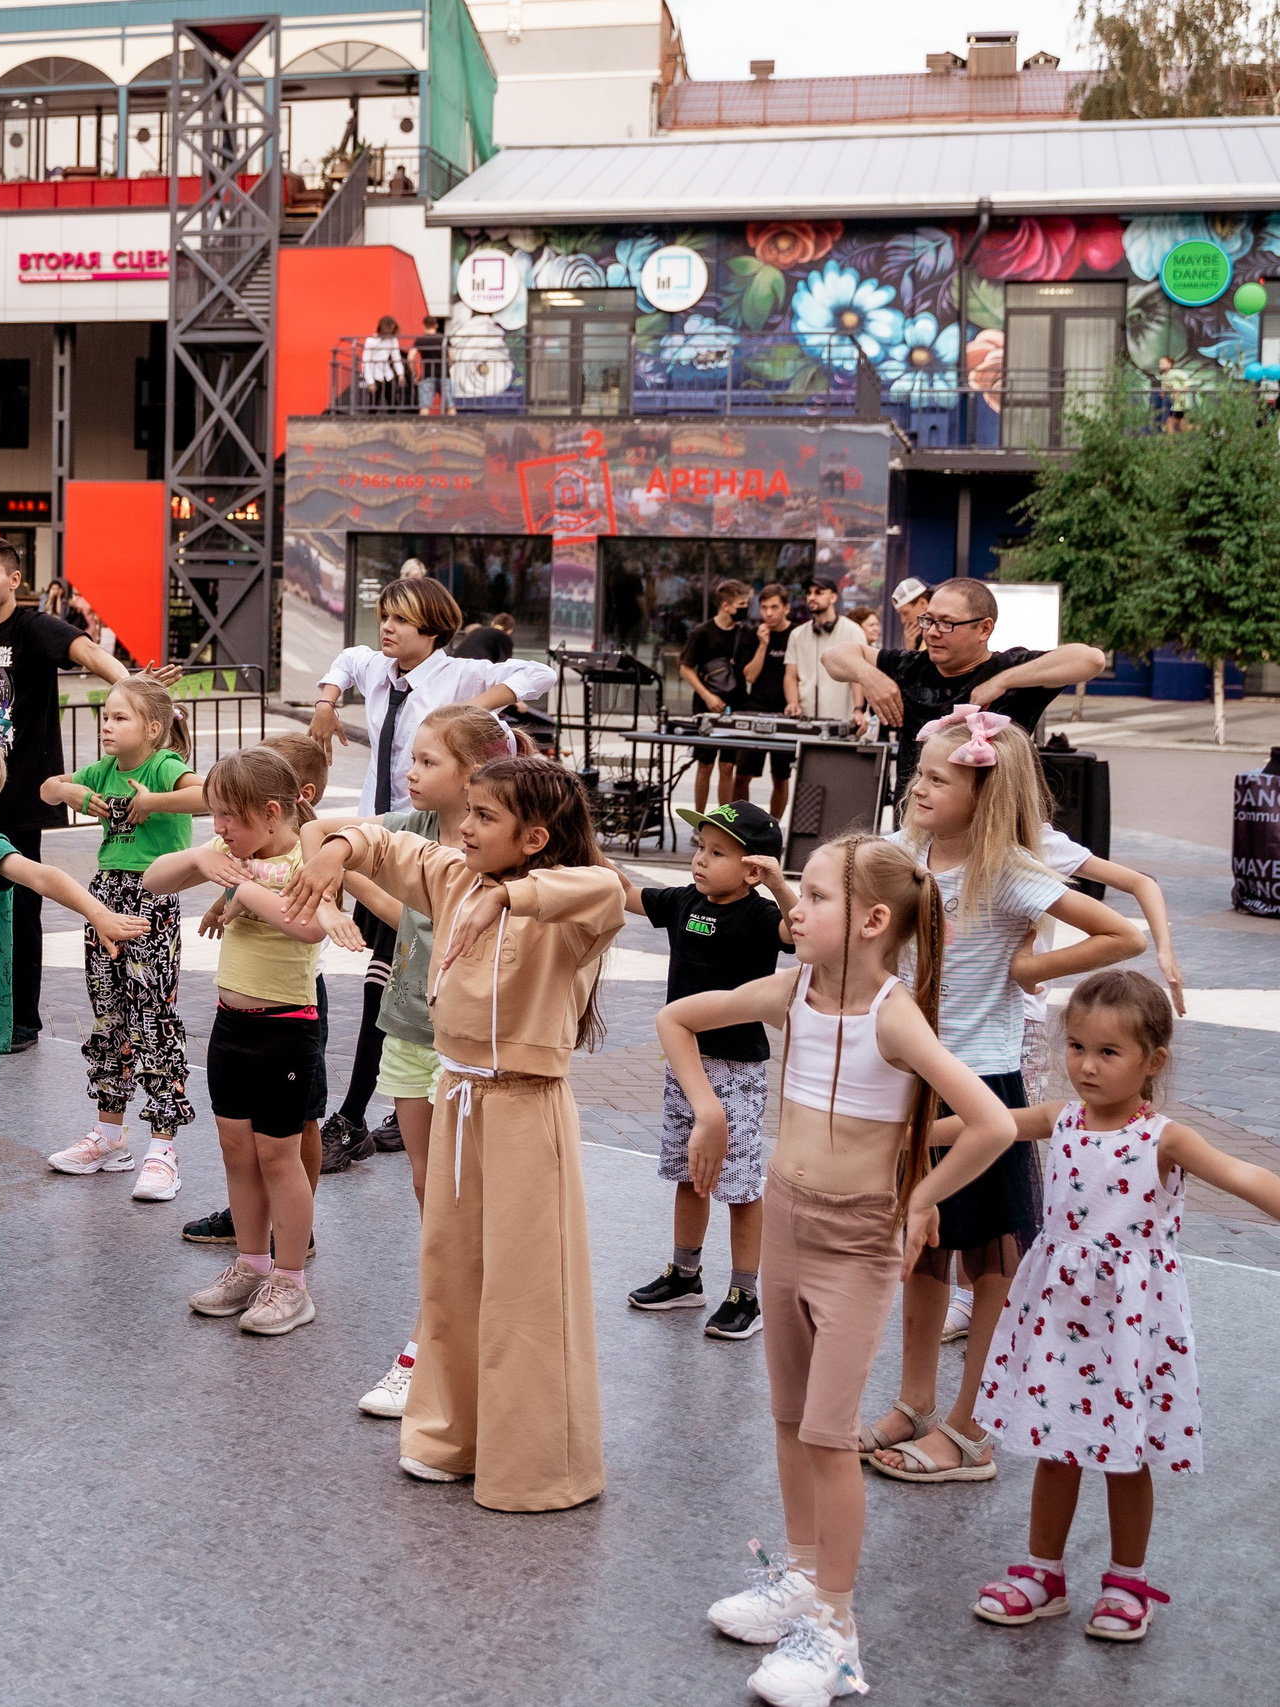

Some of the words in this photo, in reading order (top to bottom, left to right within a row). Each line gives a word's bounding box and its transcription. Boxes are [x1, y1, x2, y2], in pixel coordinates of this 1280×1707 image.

[19, 252, 101, 270] ВТОРАЯ
[112, 250, 170, 272] СЦЕН
[1173, 253, 1220, 266] MAYBE
[1173, 267, 1220, 280] DANCE
[1173, 281, 1218, 290] COMMUNITY
[338, 473, 358, 488] +7
[361, 473, 391, 489] 965
[394, 474, 426, 490] 669
[429, 475, 449, 490] 75
[453, 475, 473, 490] 15
[646, 467, 791, 501] АРЕНДА
